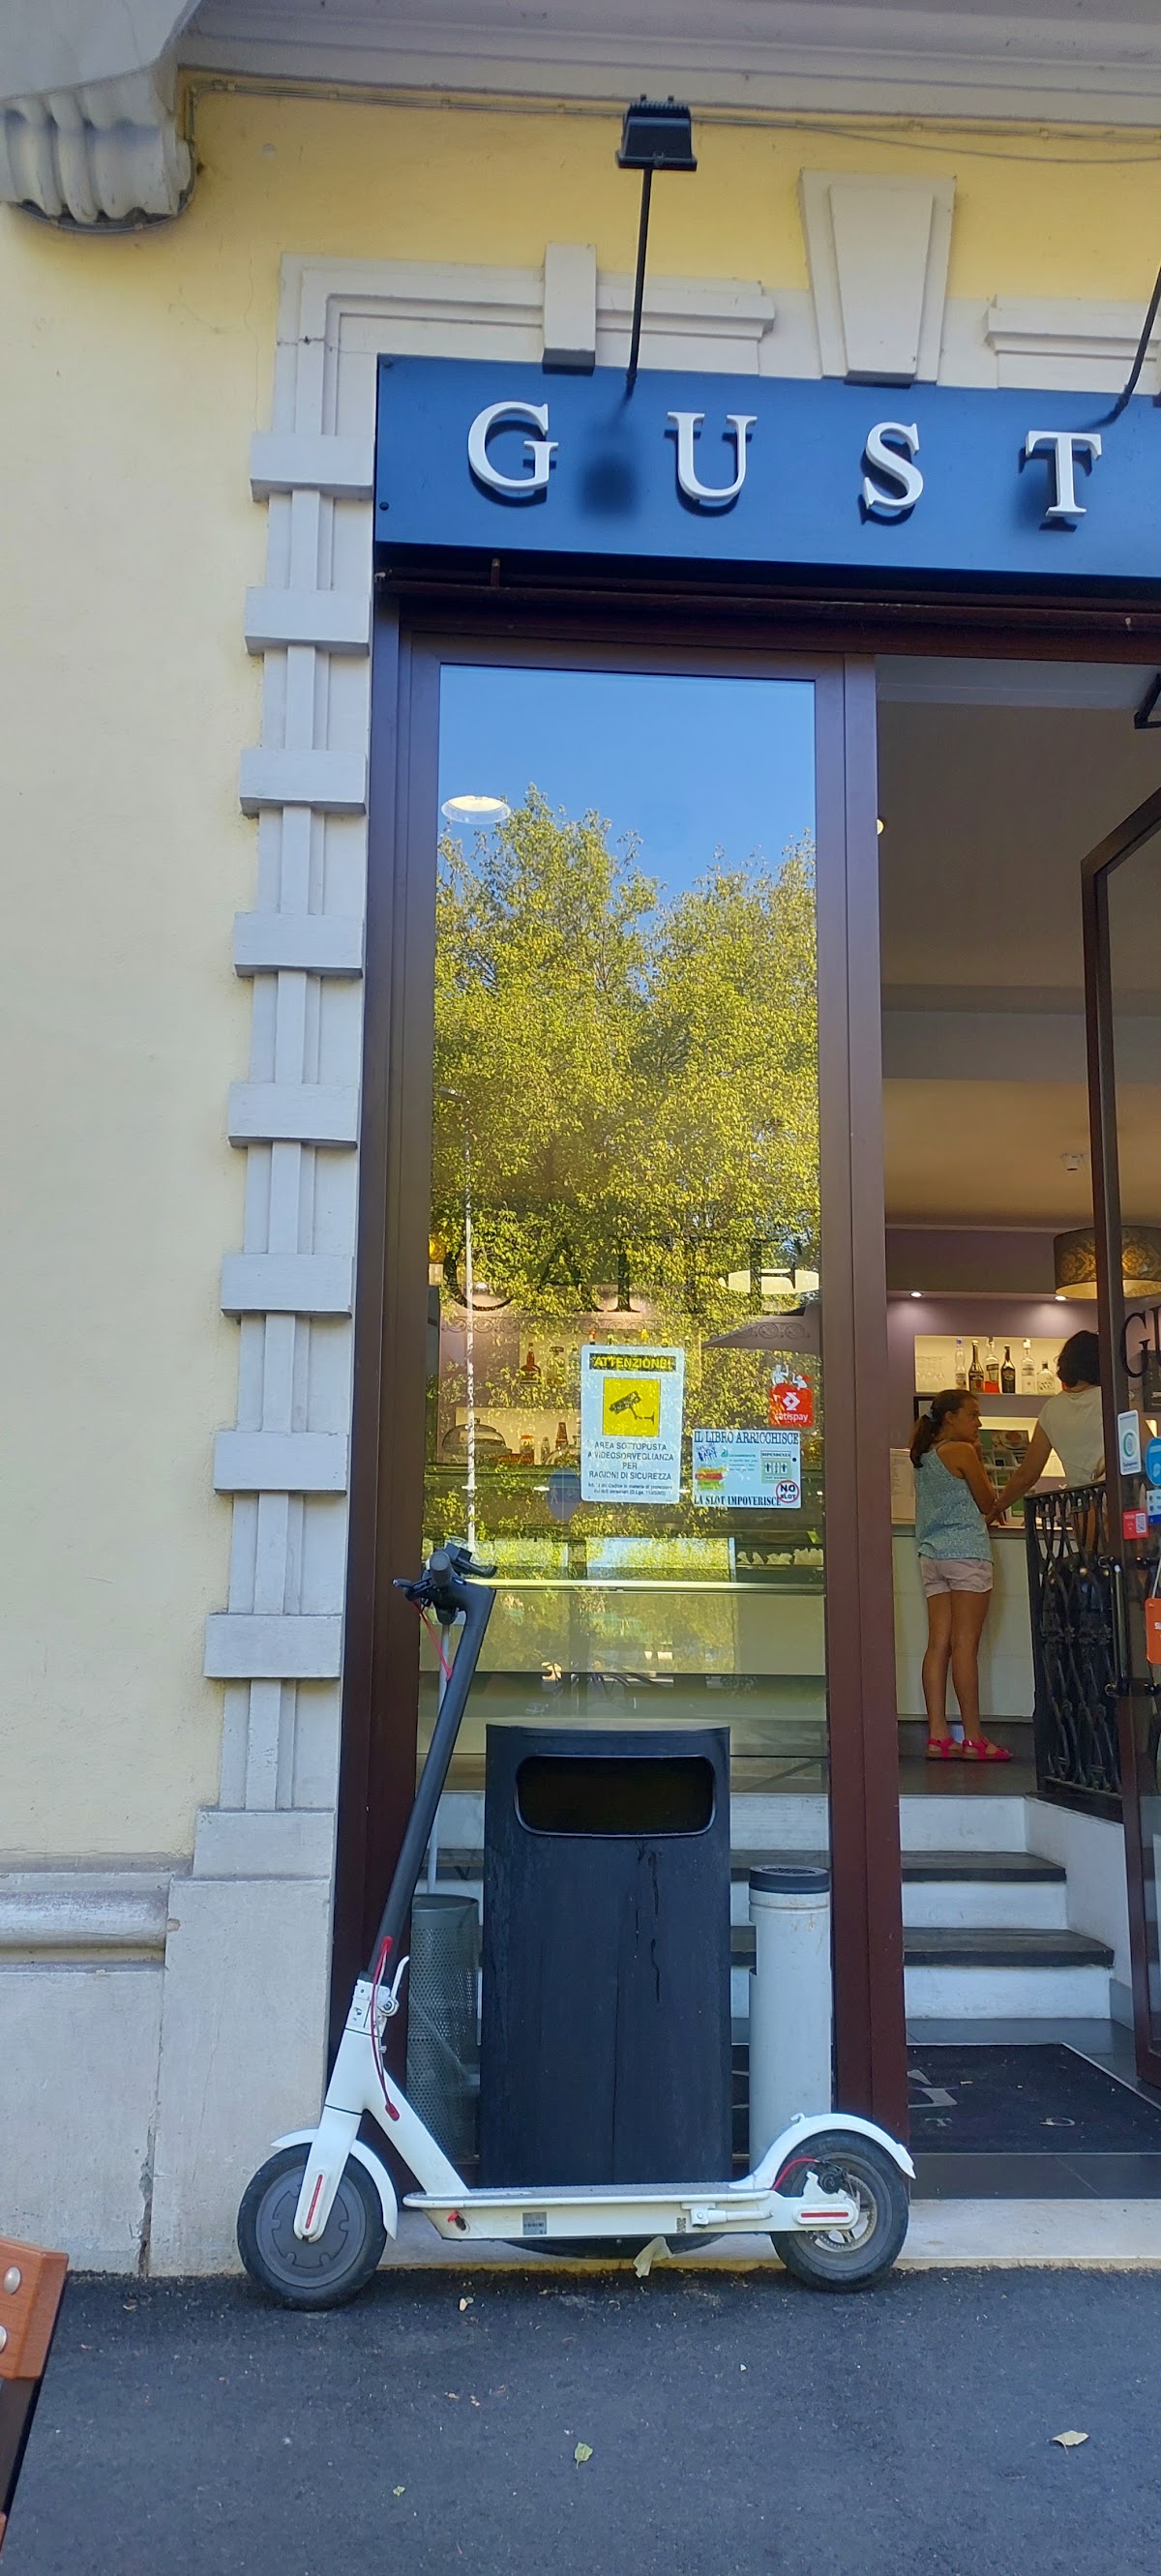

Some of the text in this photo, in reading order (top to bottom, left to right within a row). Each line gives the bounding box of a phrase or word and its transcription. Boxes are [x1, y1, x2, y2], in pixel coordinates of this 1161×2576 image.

[593, 1356, 671, 1370] ATTENZIONE!
[694, 1431, 799, 1445] IL LIBRO ARRICCHISCE
[594, 1452, 674, 1461] VIDEOSORVEGLIANZA
[589, 1470, 619, 1479] RAGIONI
[780, 1484, 796, 1493] NO
[694, 1495, 782, 1507] LA SLOT IMPOVERISCE
